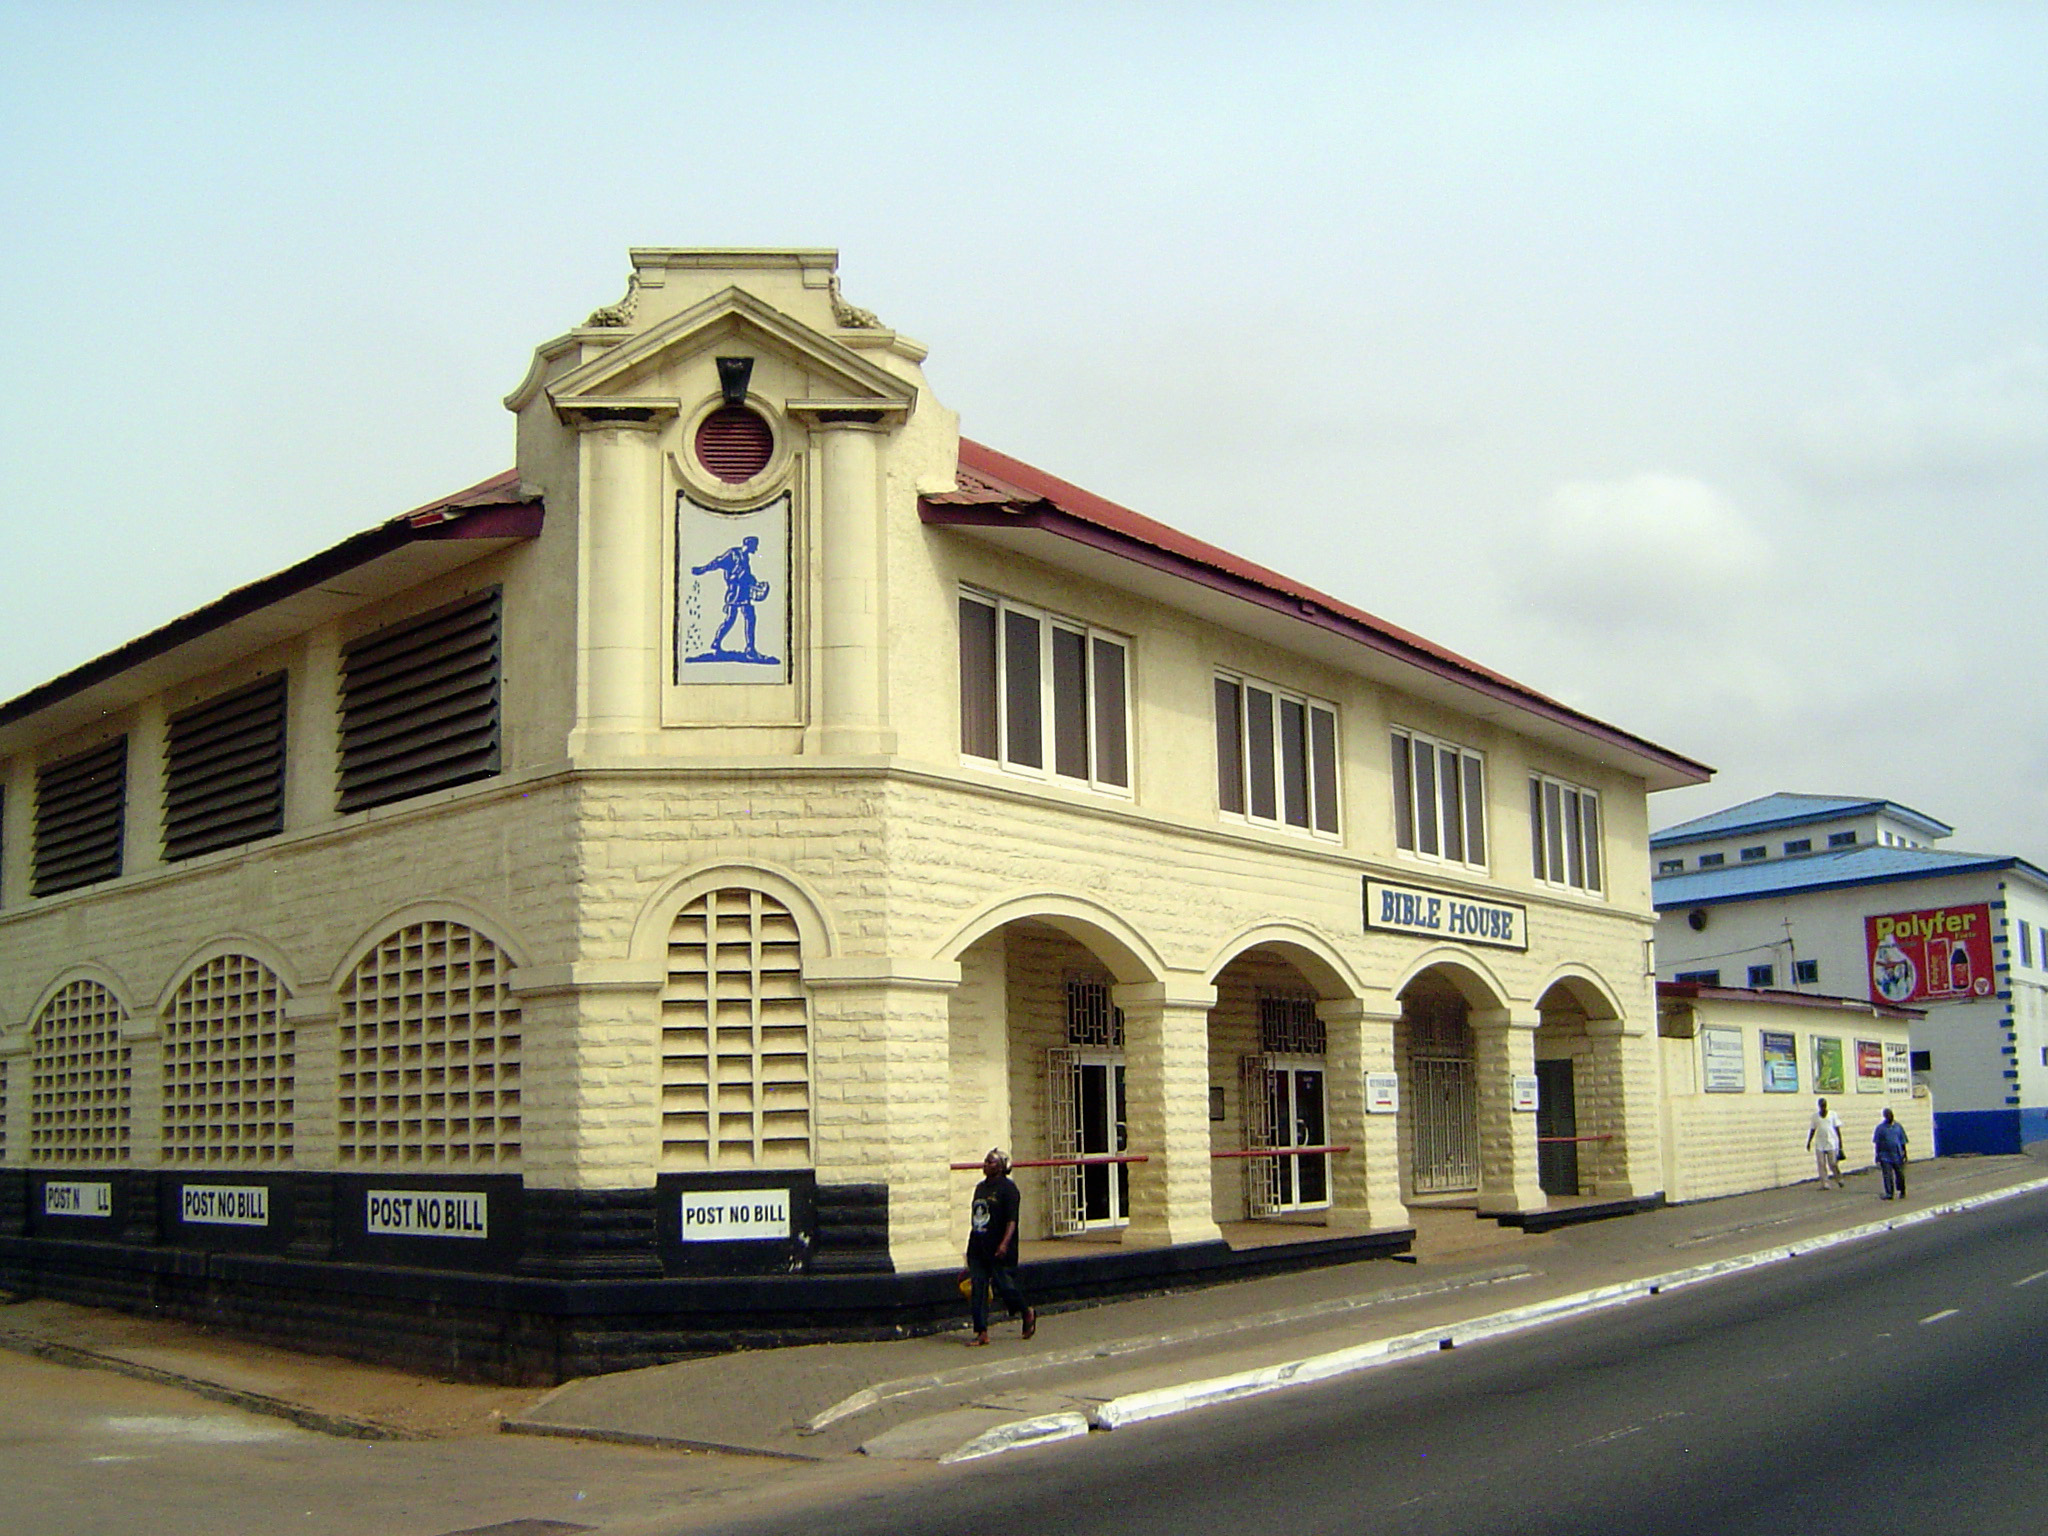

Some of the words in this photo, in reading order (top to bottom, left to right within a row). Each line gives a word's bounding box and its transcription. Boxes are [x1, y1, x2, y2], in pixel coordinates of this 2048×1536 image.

[1381, 889, 1441, 929] BIBLE
[1448, 901, 1513, 940] HOUSE
[1876, 911, 1976, 941] Polyfer
[48, 1187, 71, 1209] POST
[185, 1190, 215, 1216] POST
[218, 1191, 235, 1218] NO
[238, 1192, 264, 1219] BILL
[371, 1197, 412, 1227] POST
[417, 1198, 440, 1228] NO
[445, 1199, 483, 1231] BILL
[686, 1206, 724, 1225] POST
[730, 1205, 750, 1223] NO
[754, 1204, 785, 1222] BILL
